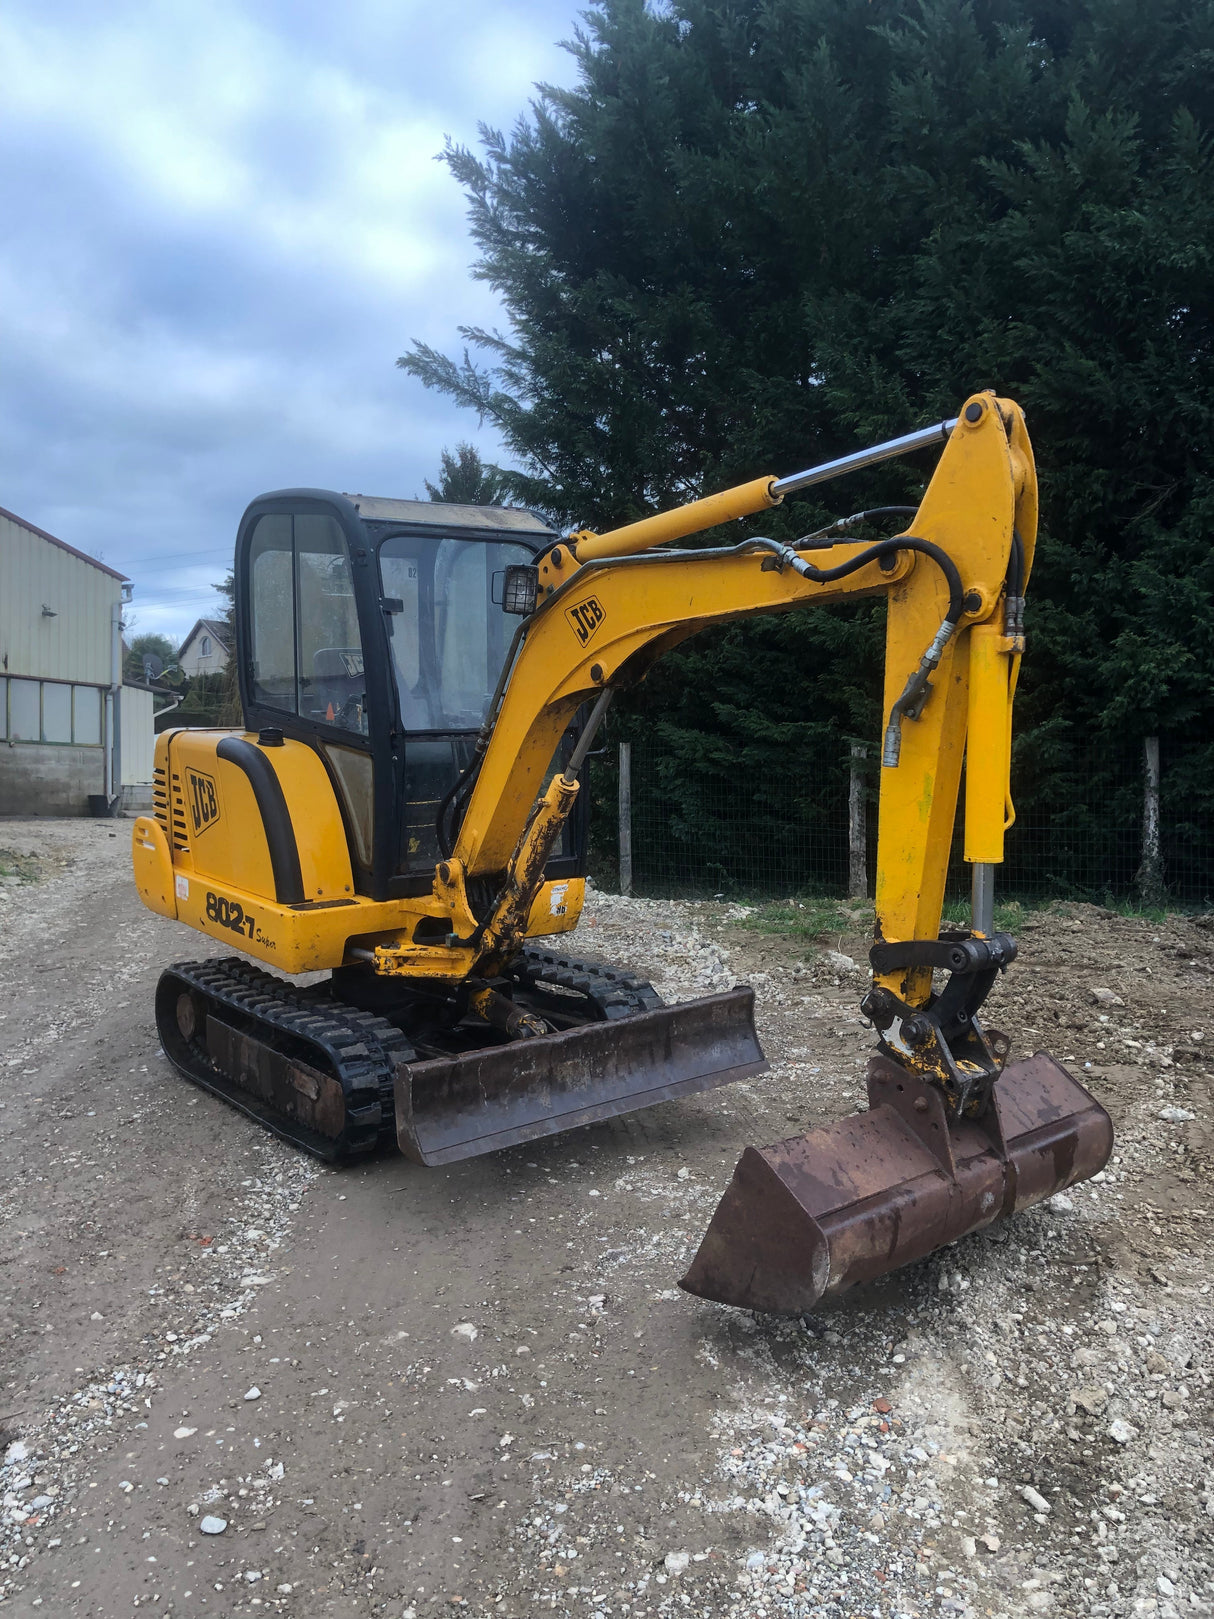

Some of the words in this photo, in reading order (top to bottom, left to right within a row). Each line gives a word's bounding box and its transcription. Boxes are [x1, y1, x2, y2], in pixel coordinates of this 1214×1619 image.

[570, 599, 603, 643] JCB
[344, 654, 365, 677] JC
[190, 773, 217, 831] JCB
[256, 928, 277, 951] Super
